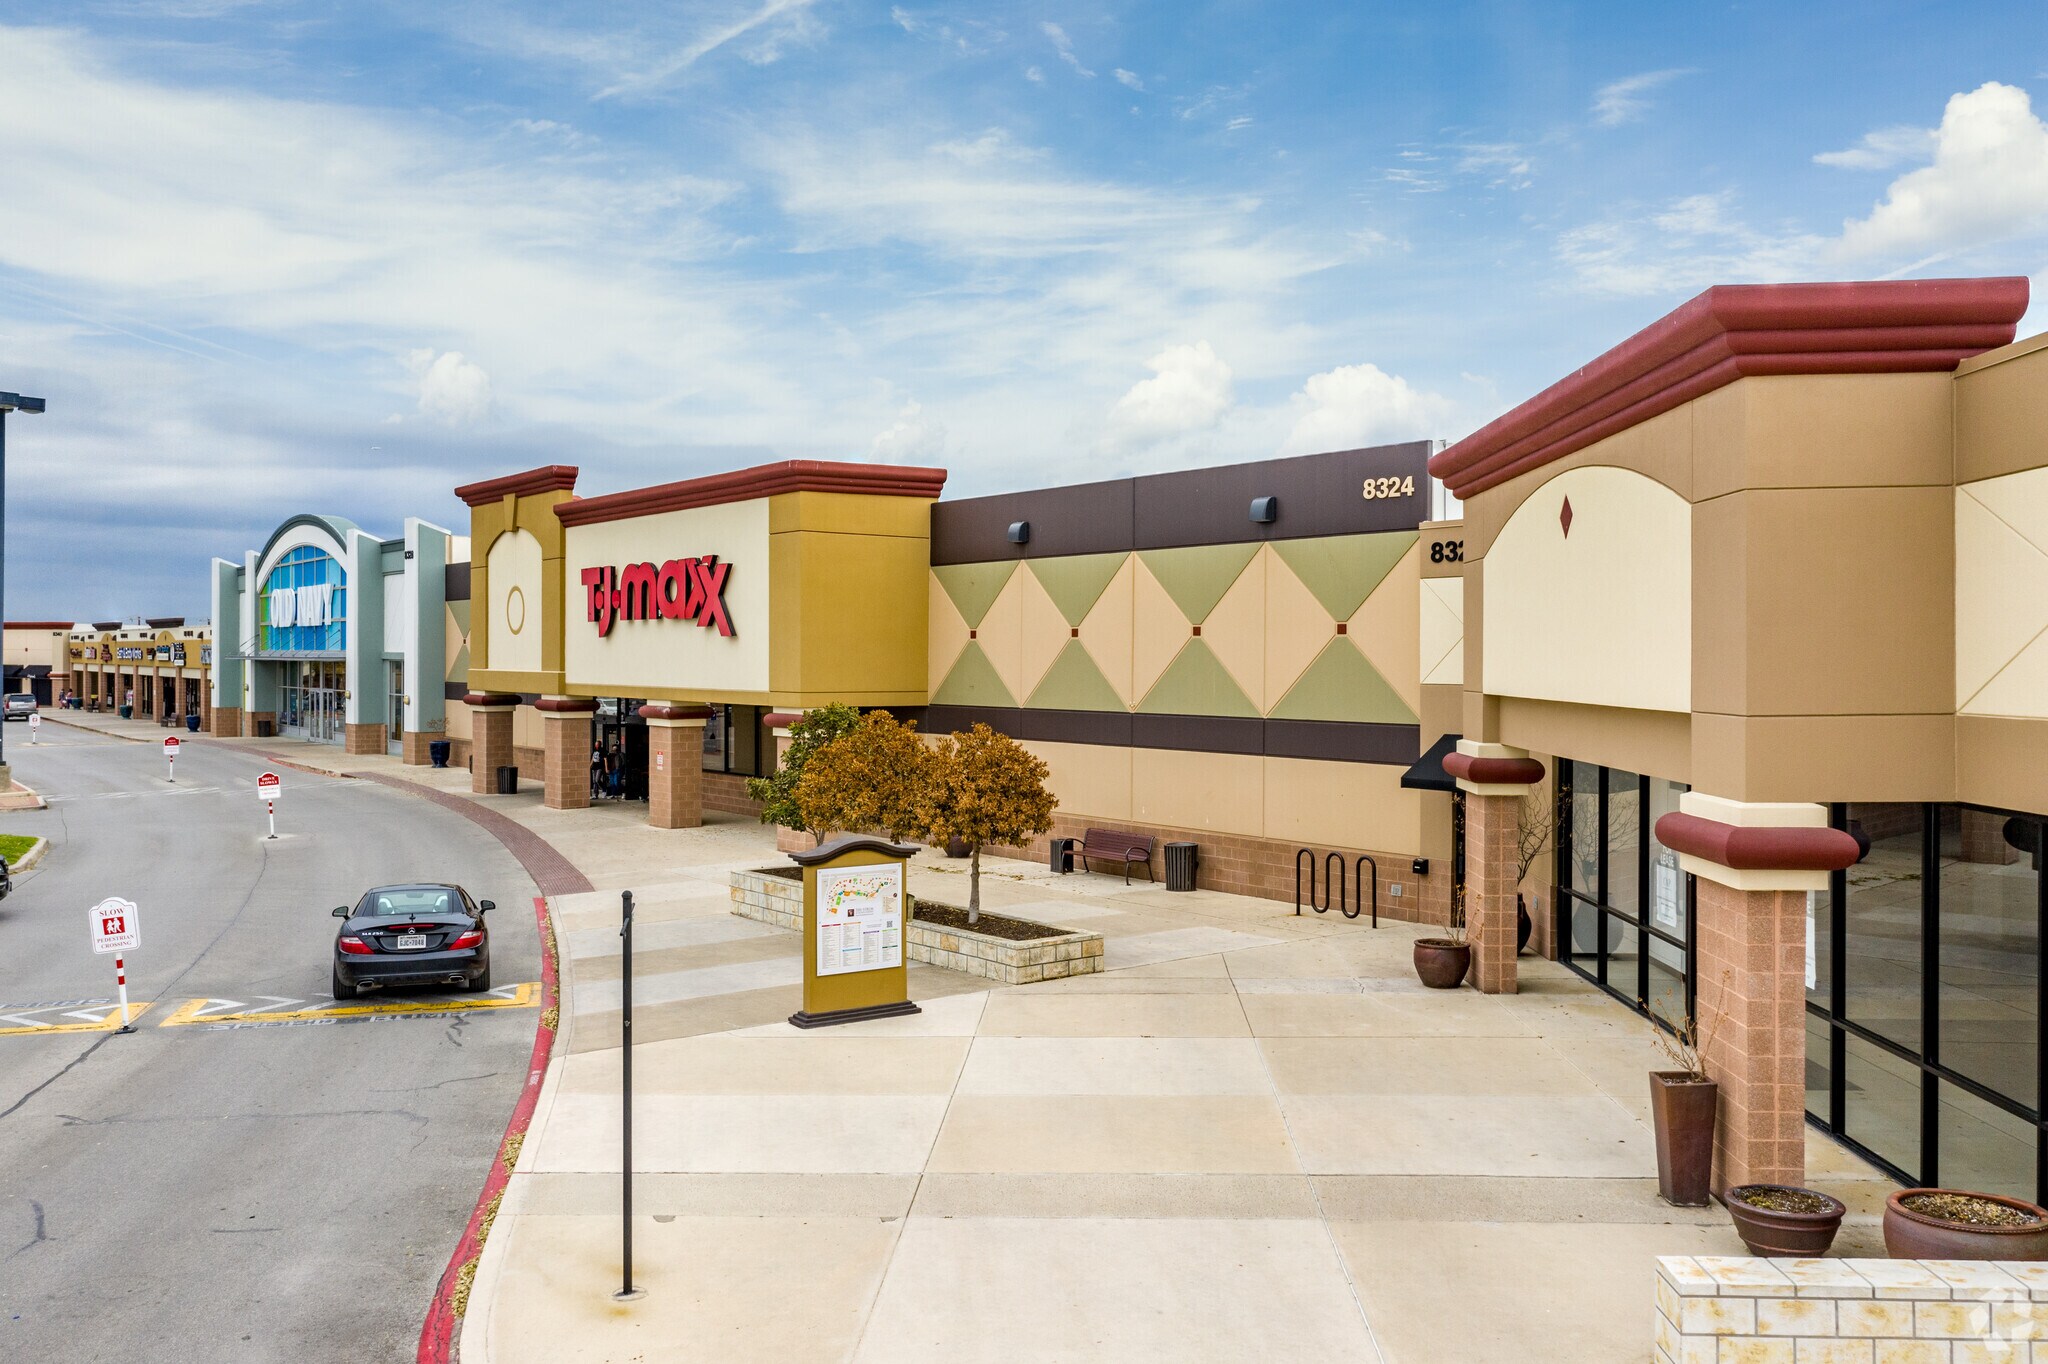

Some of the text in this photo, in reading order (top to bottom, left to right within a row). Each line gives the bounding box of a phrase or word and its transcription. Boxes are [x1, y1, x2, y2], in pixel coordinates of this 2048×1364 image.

[1362, 475, 1415, 500] 8324
[270, 583, 334, 629] OLD NAVY
[1660, 854, 1675, 868] LEASE
[99, 908, 125, 917] SLOW
[96, 934, 135, 944] PEDESTRIAN
[100, 940, 132, 949] CROSSING
[207, 1018, 338, 1031] SPEED
